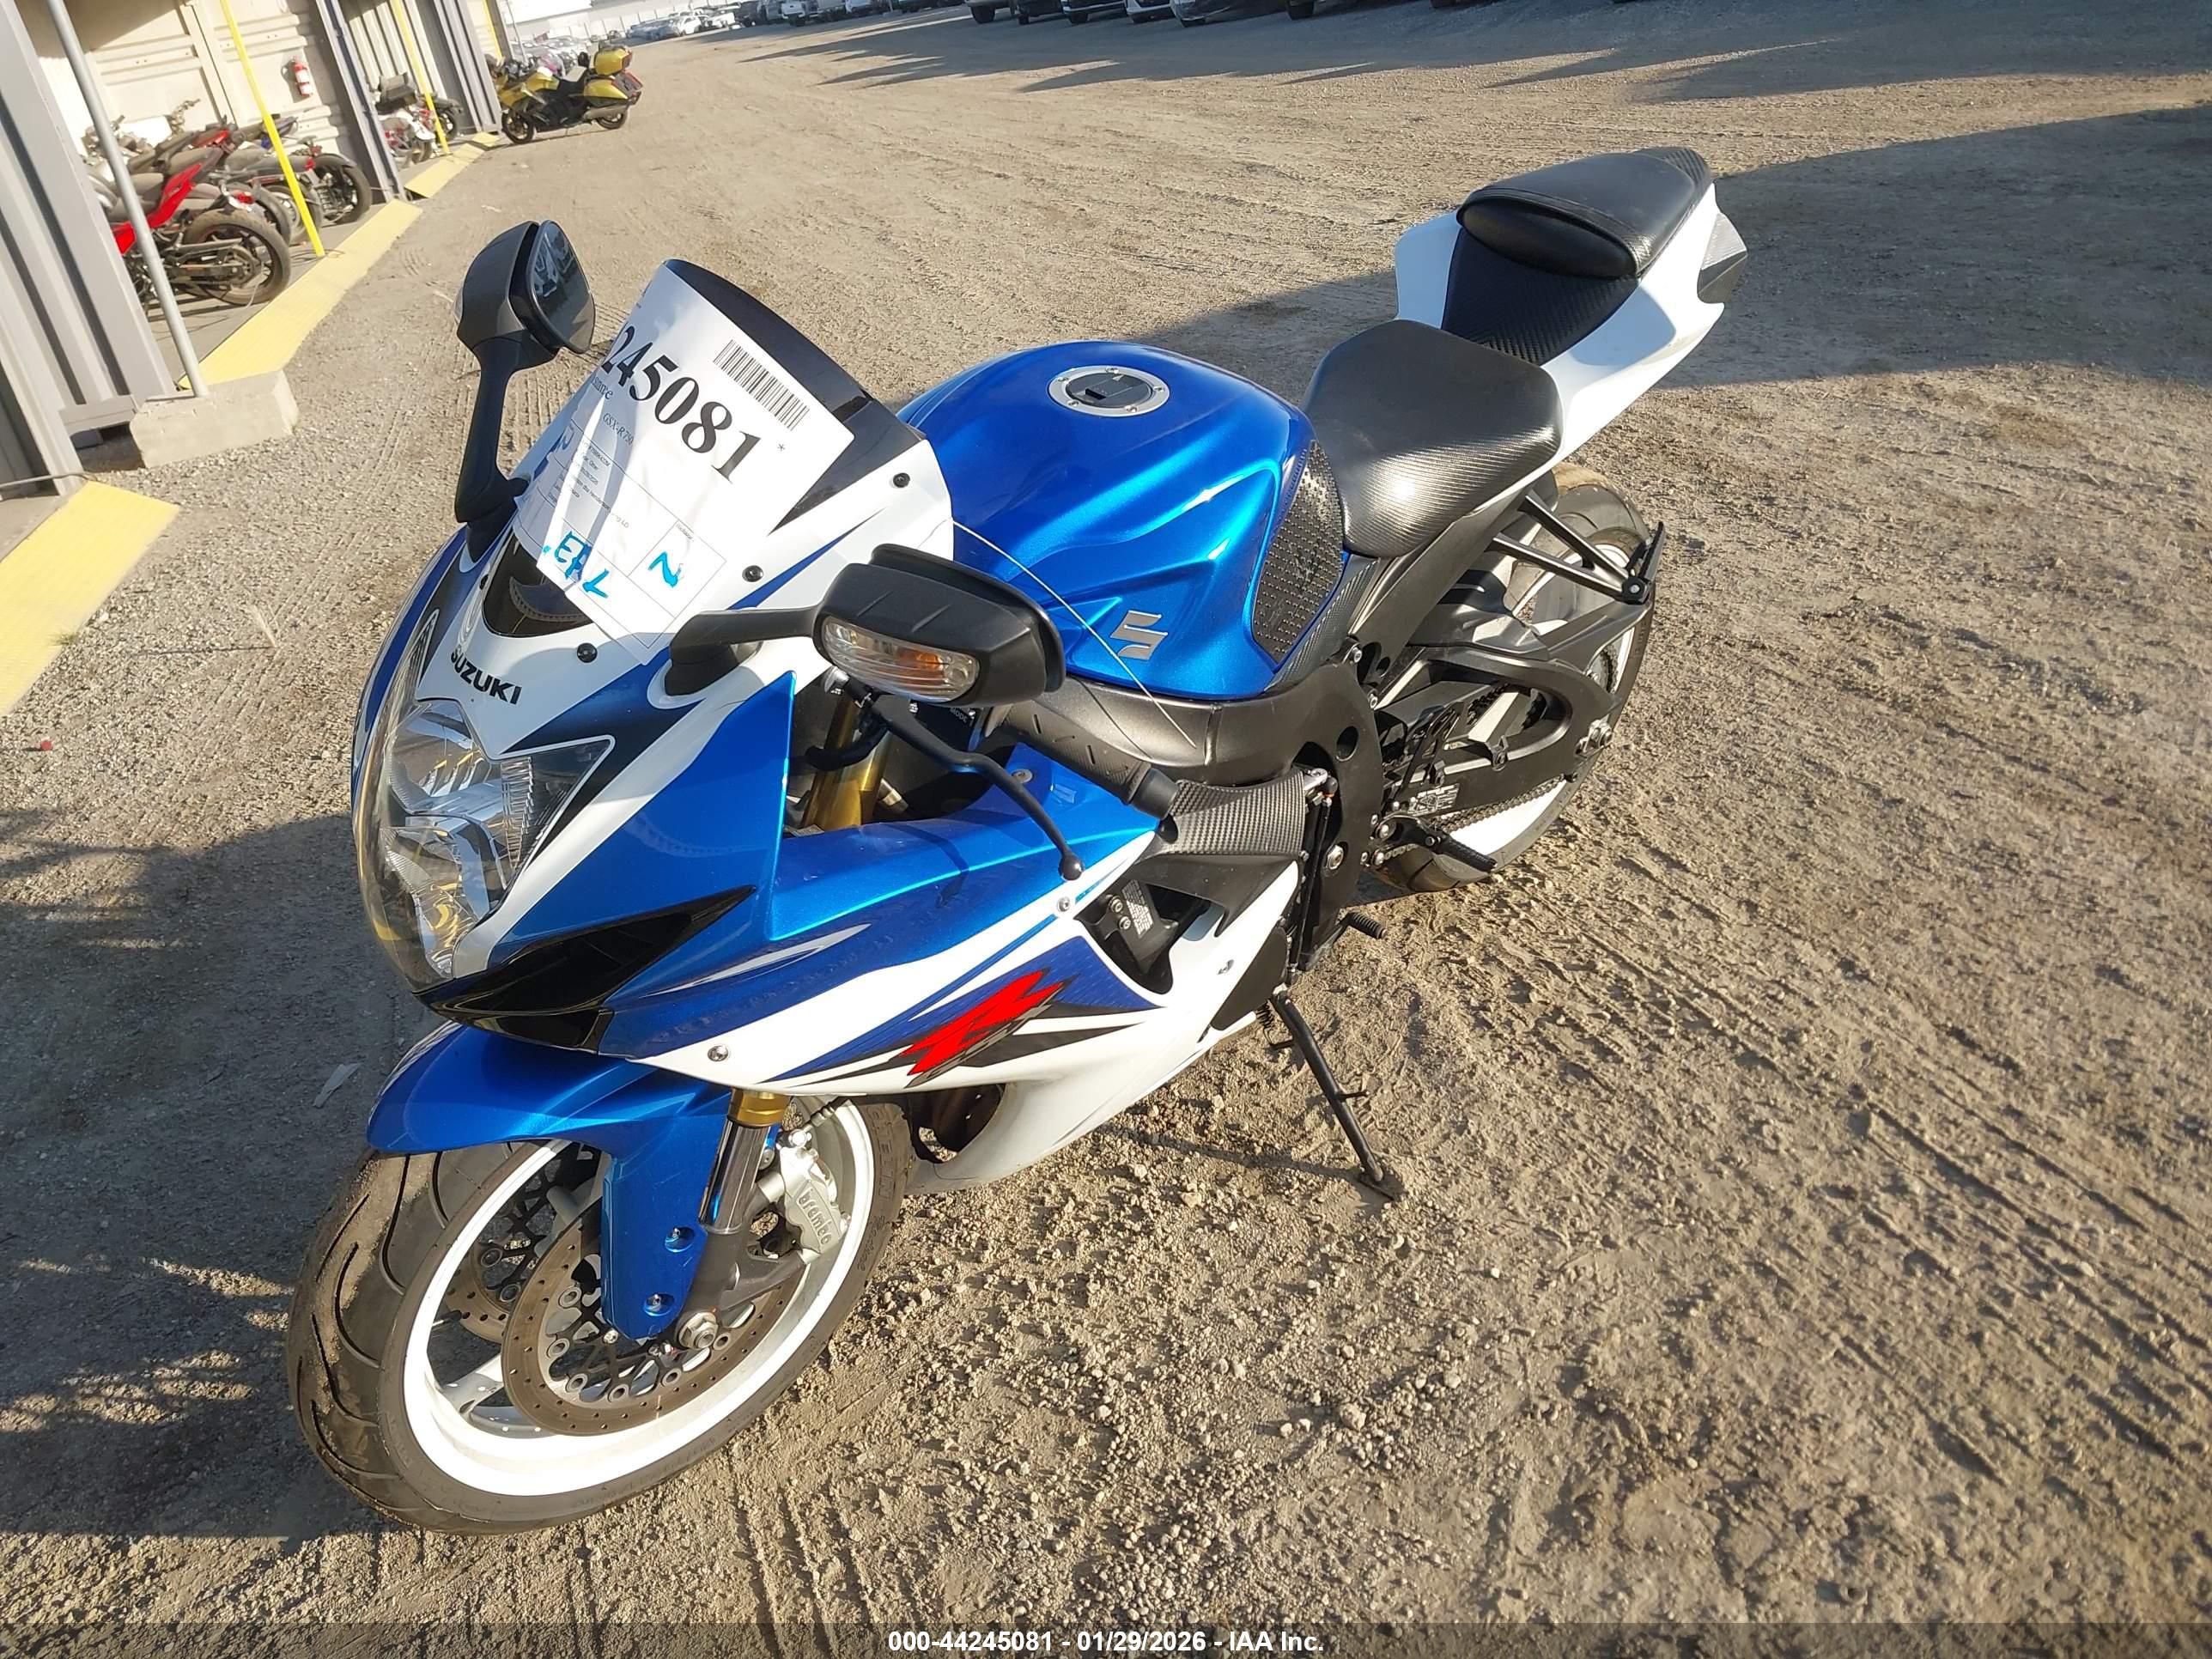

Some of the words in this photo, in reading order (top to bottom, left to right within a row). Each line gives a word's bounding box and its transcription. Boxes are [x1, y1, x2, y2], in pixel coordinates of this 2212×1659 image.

[602, 412, 635, 446] GSX-R750
[451, 644, 522, 705] SUZUKI
[798, 1188, 832, 1245] brembo
